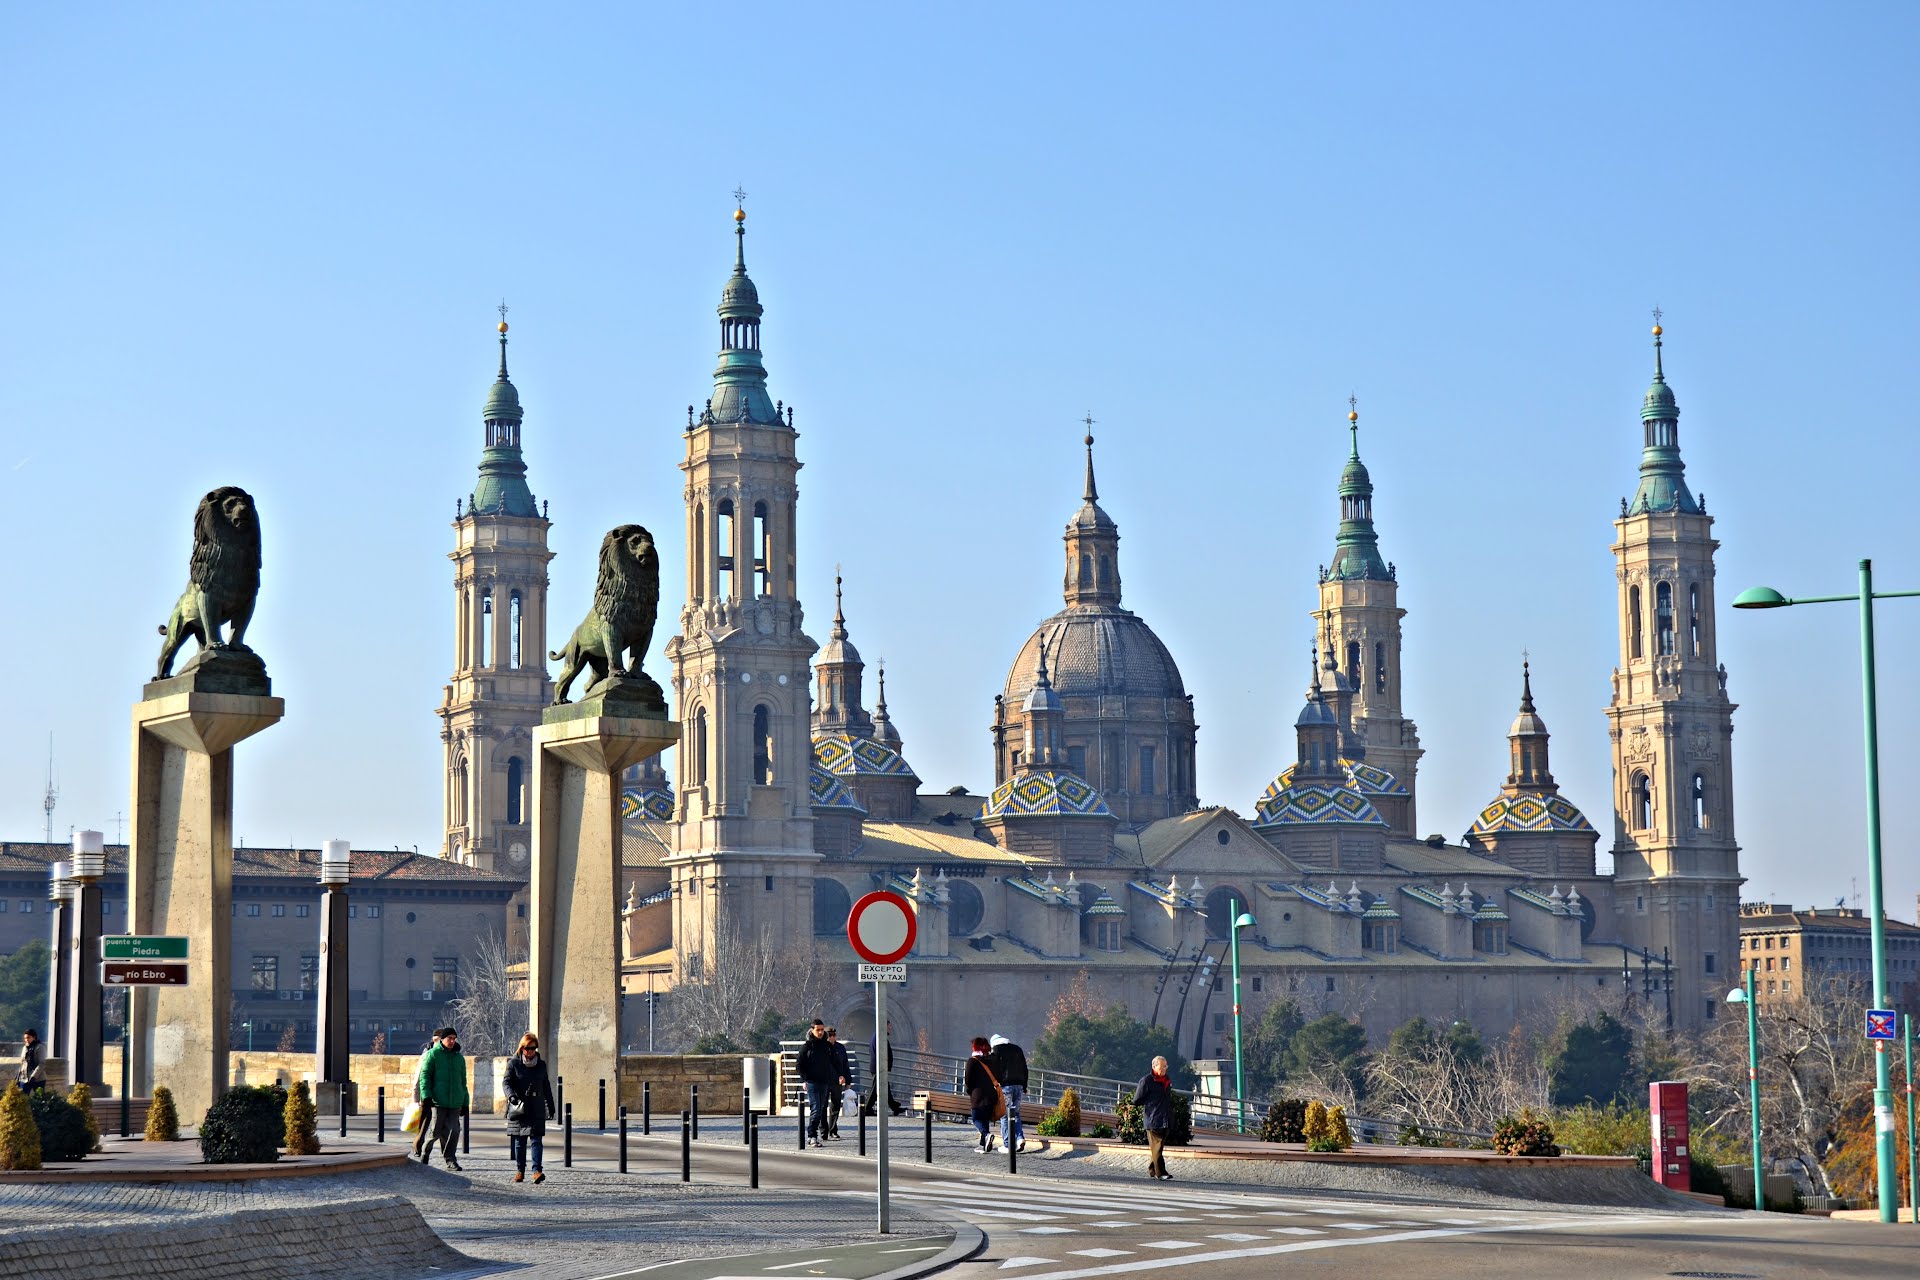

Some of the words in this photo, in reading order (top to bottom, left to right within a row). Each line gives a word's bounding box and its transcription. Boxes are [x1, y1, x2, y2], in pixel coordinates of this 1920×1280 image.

[132, 947, 160, 955] Piedra
[864, 965, 903, 973] EXCEPTO
[126, 970, 140, 978] río
[142, 970, 166, 978] Ebro
